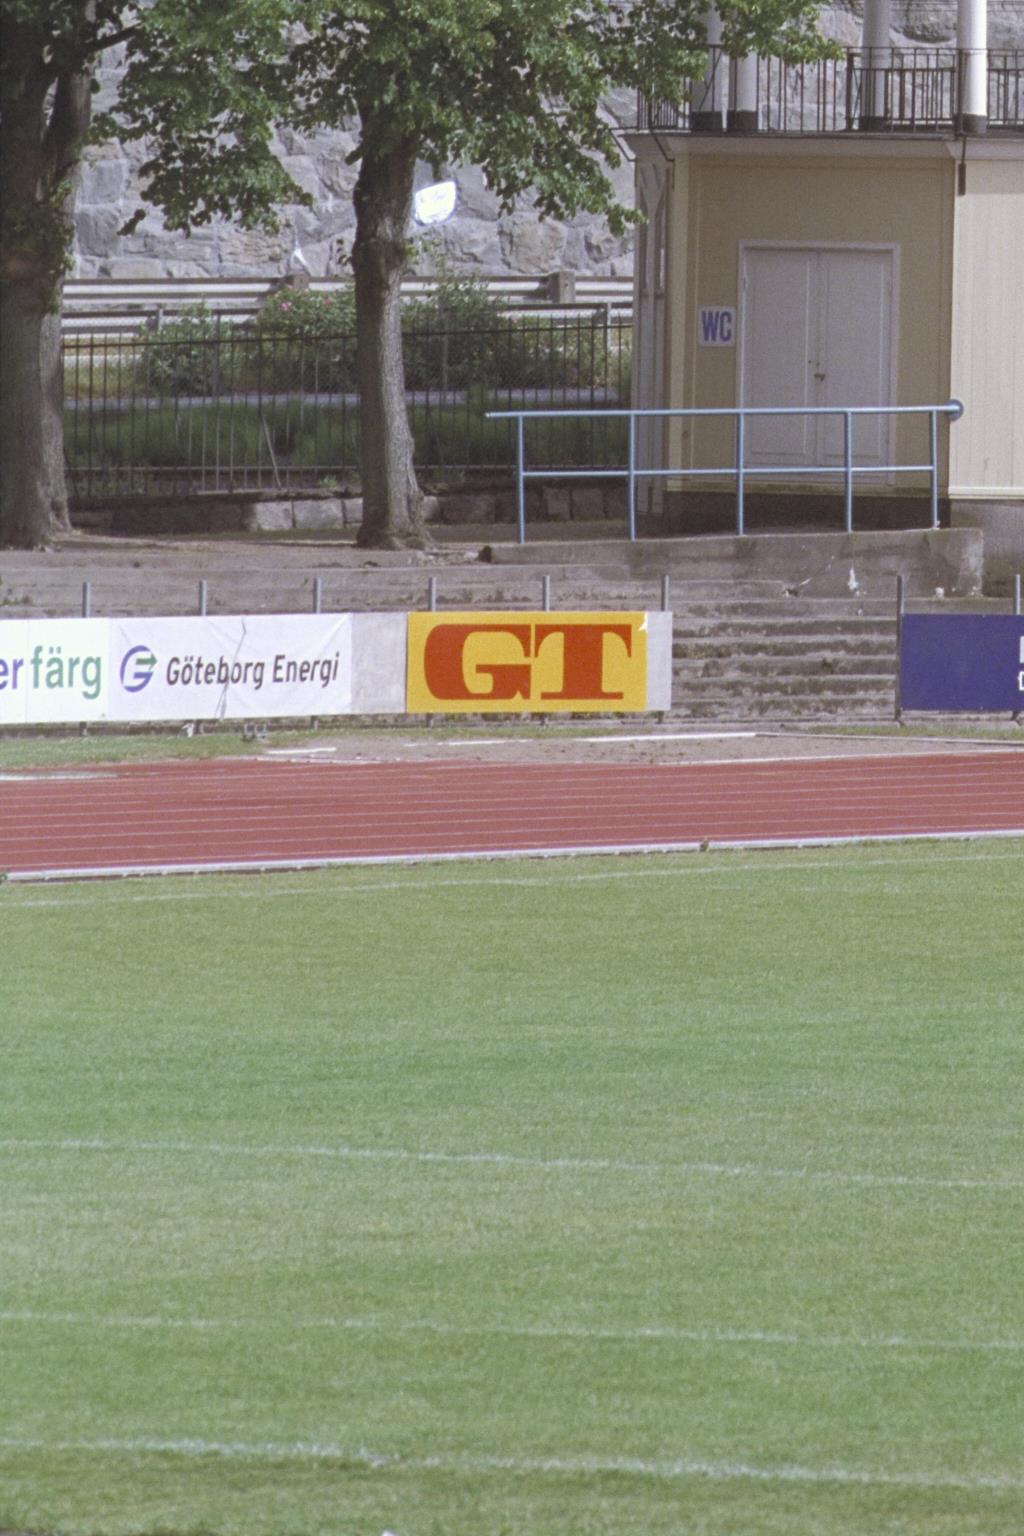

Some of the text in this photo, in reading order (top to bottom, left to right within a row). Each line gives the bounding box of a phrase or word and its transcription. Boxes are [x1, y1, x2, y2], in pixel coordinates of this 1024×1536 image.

[701, 310, 733, 342] WC
[30, 645, 102, 700] färg
[166, 651, 341, 691] Göteborg Energi
[423, 623, 634, 701] GT
